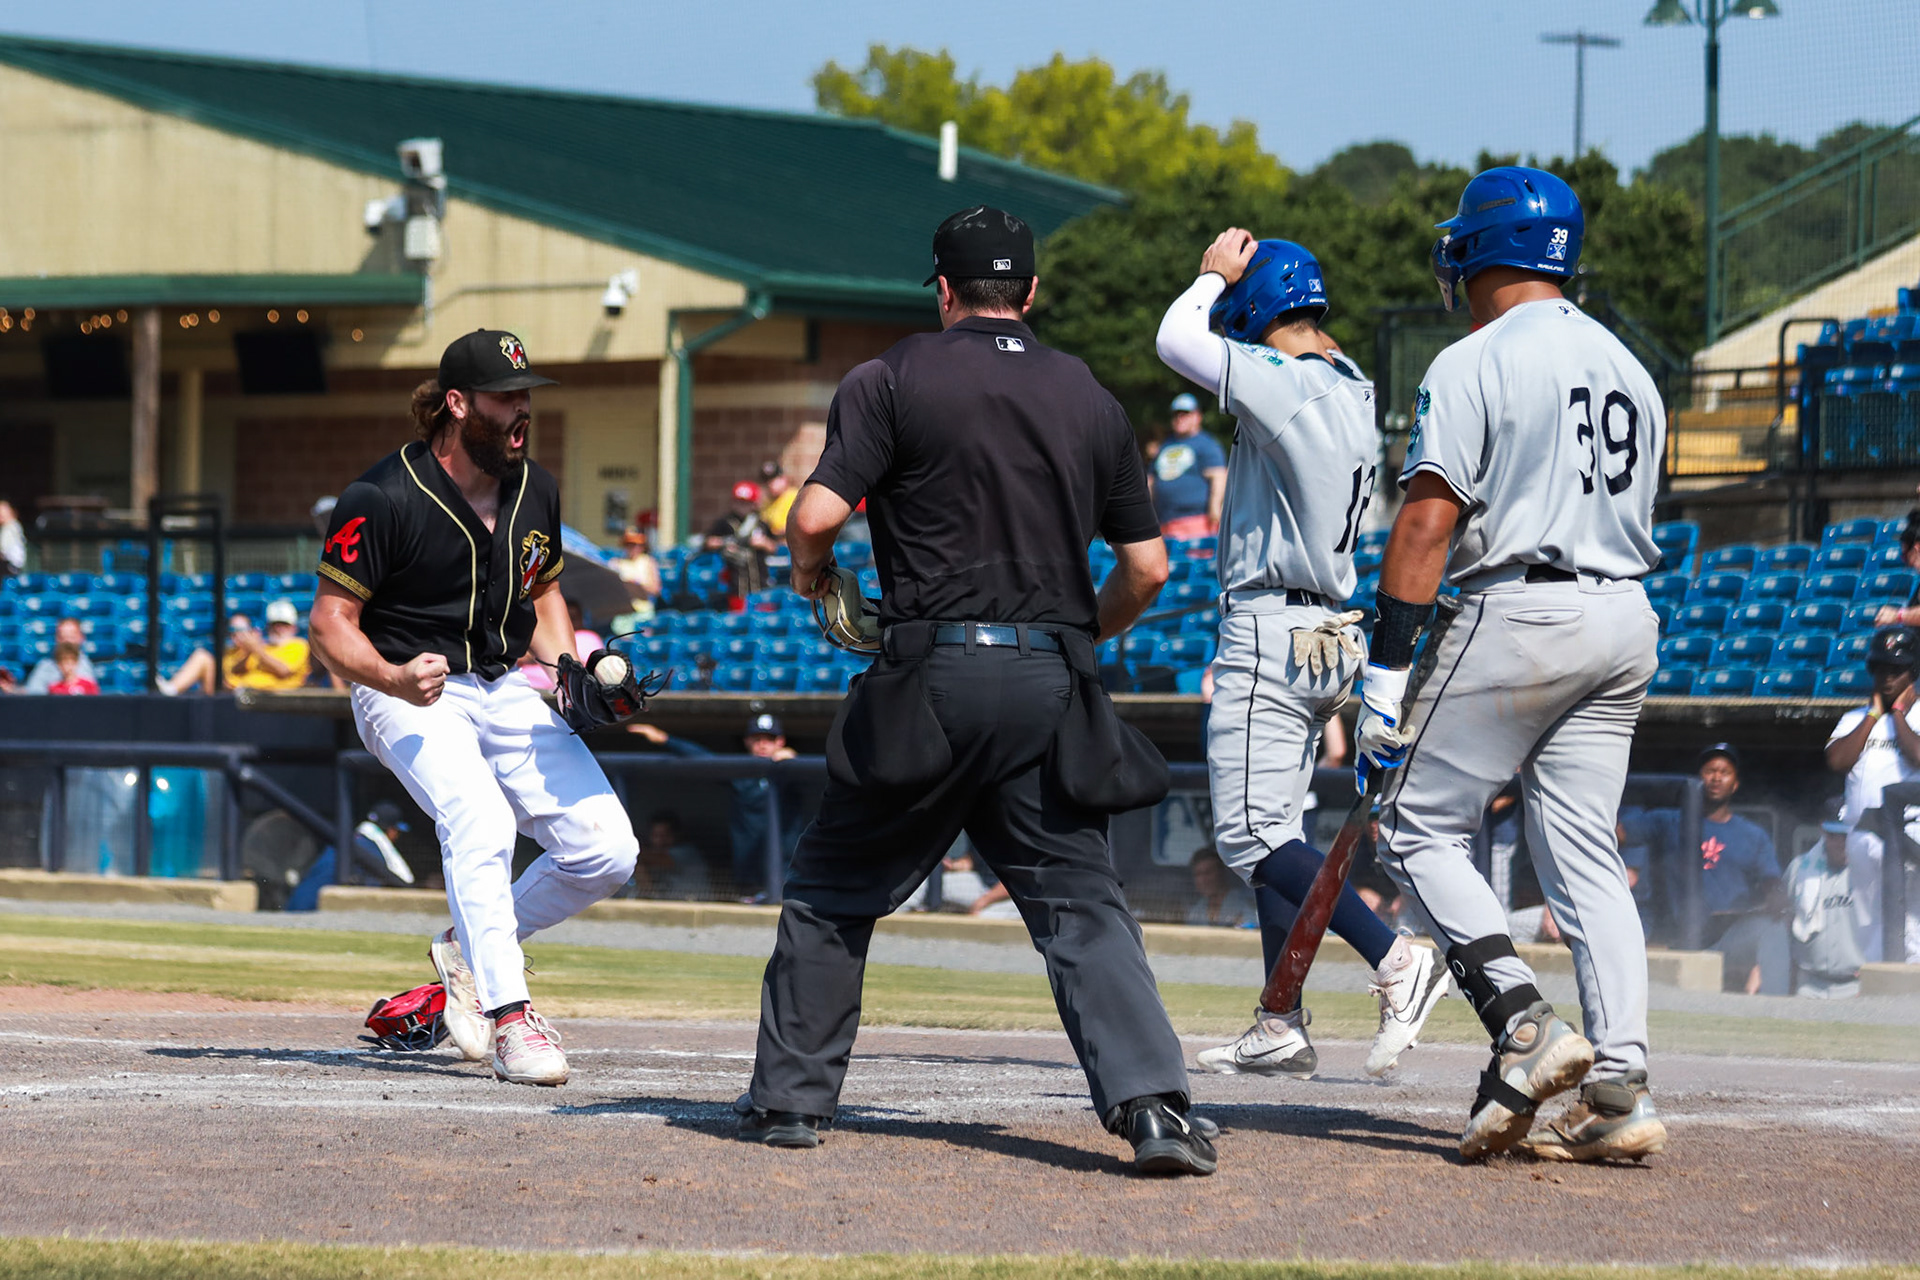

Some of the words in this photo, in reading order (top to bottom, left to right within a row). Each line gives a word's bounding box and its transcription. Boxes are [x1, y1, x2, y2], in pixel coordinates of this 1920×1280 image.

[1551, 227, 1568, 244] 39
[1568, 387, 1638, 497] 39
[325, 516, 366, 563] A
